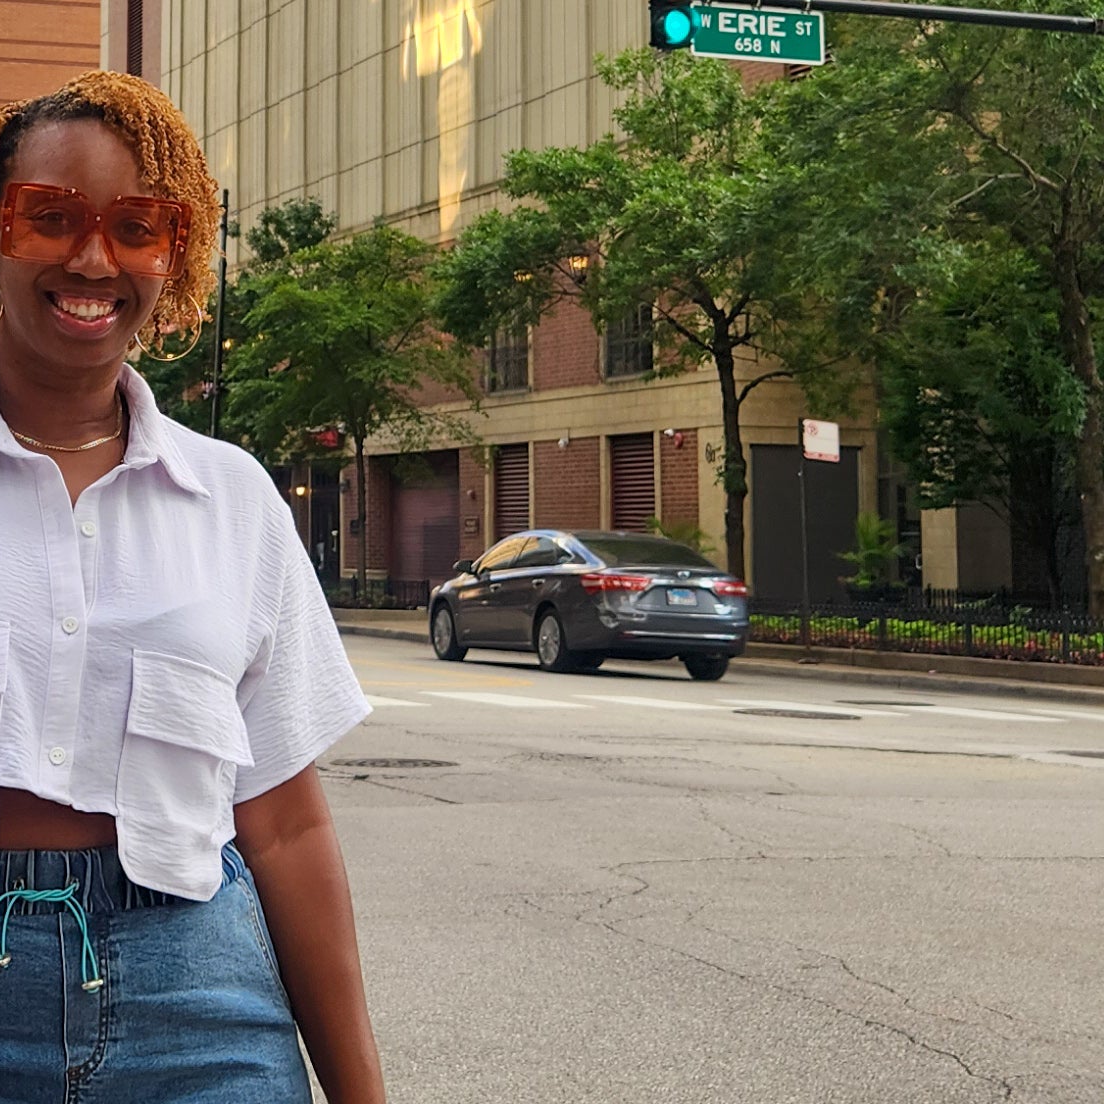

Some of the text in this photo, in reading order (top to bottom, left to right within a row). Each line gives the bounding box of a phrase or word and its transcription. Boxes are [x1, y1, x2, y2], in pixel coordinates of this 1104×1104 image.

[700, 11, 813, 37] W ERIE ST
[734, 37, 781, 54] 658 N
